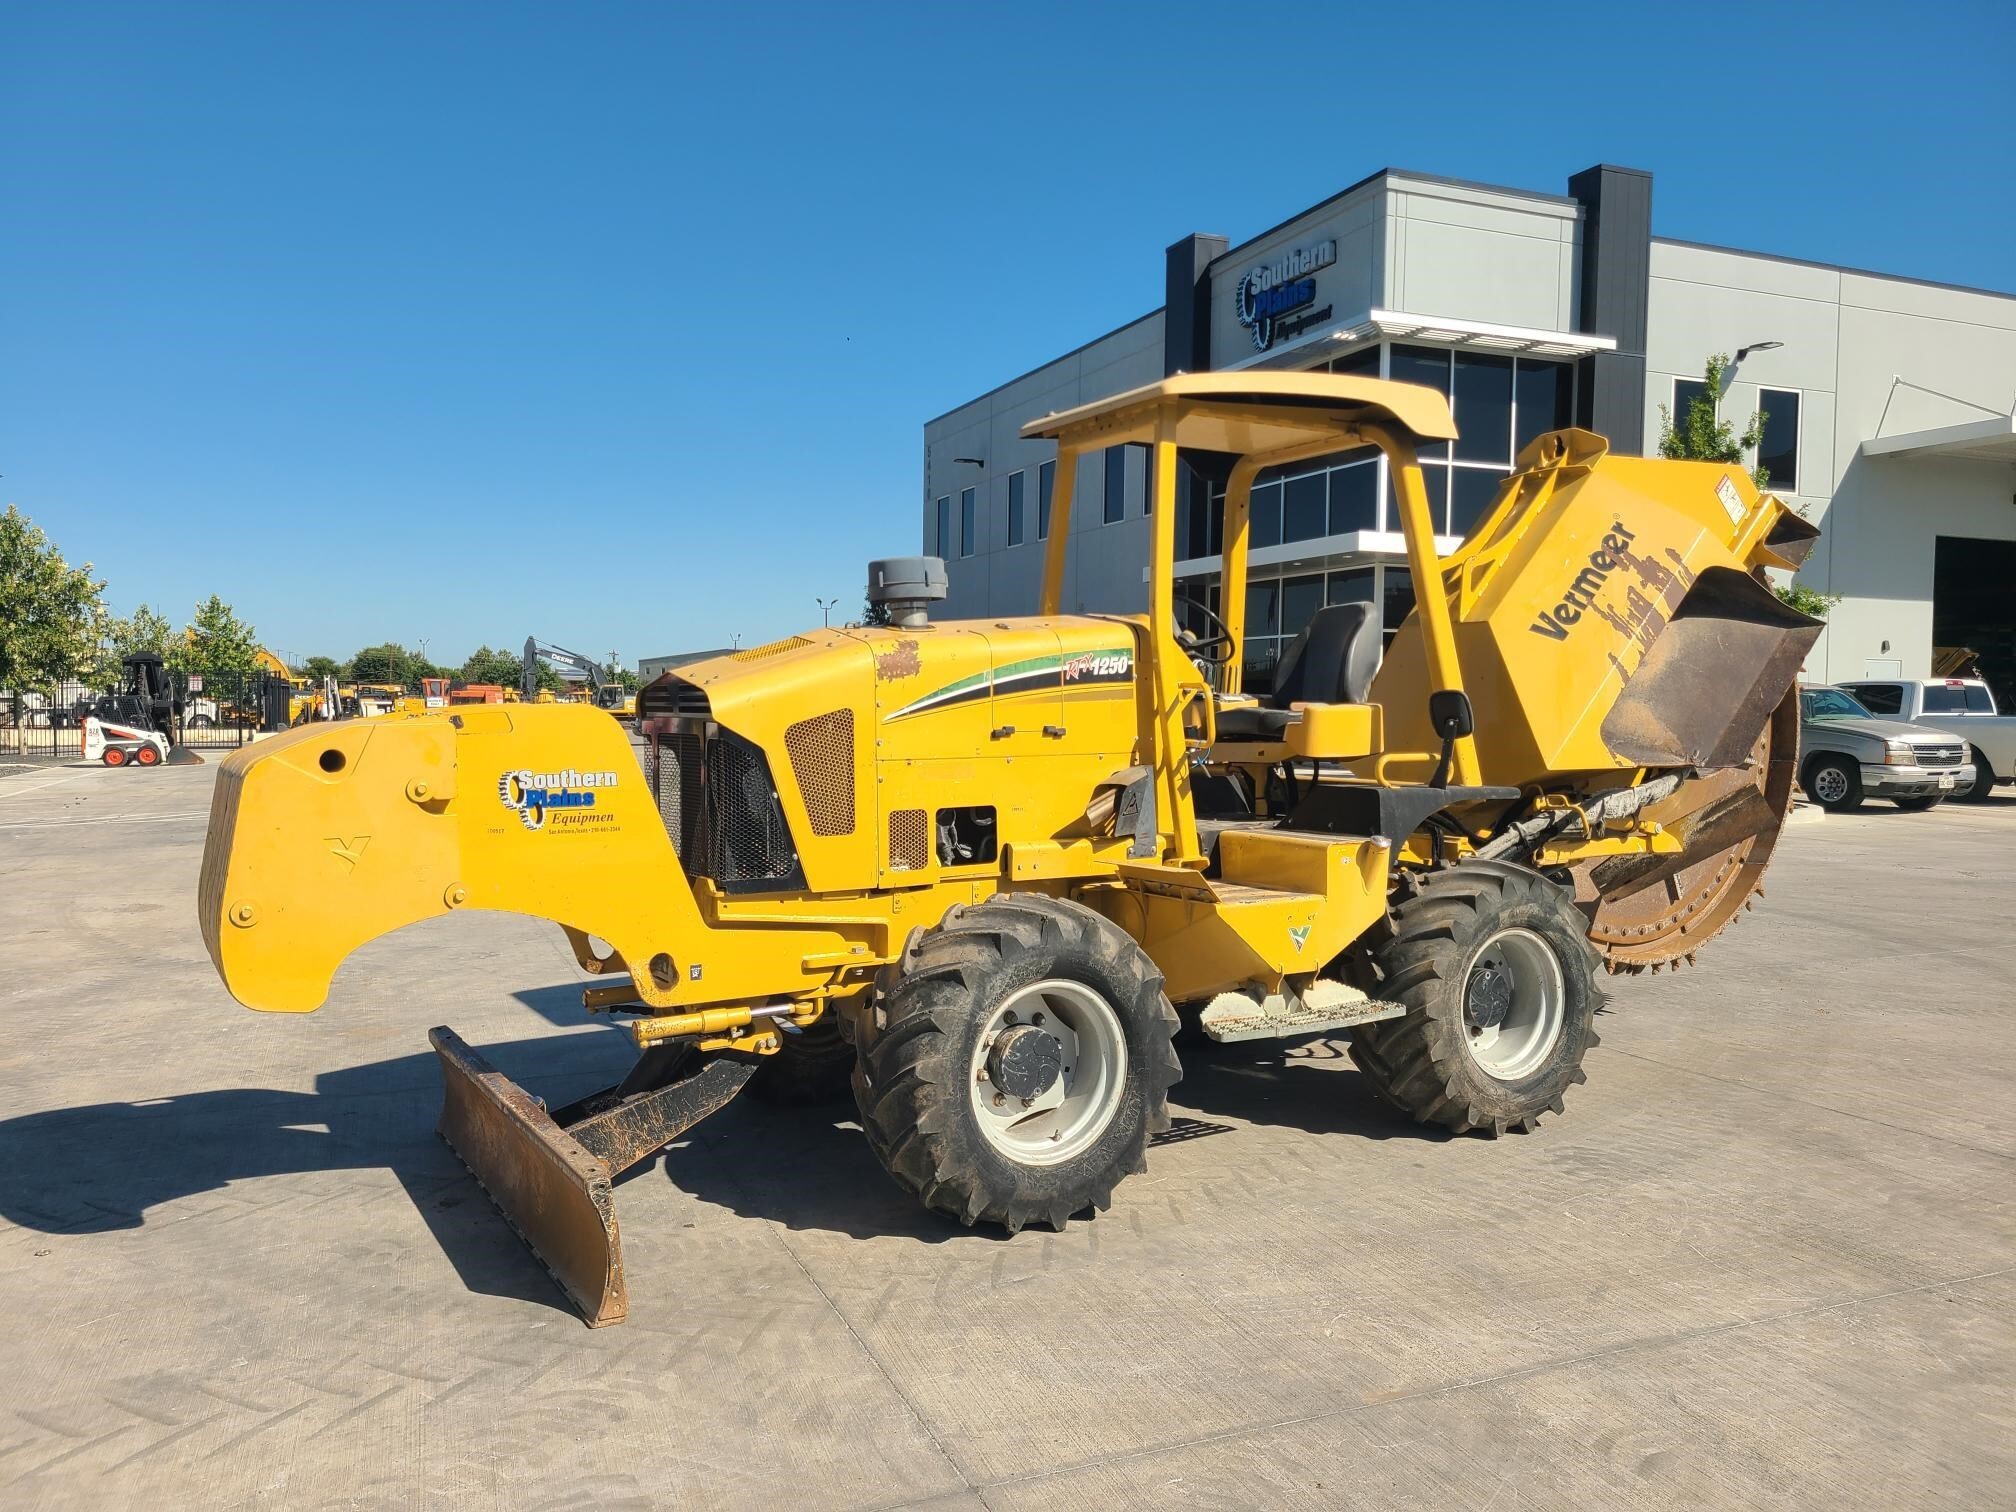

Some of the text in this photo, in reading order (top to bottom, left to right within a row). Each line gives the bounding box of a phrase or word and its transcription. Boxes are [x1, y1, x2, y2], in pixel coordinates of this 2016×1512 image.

[1250, 240, 1334, 295] Southern
[1254, 279, 1316, 321] Plains
[1528, 520, 1636, 641] Vermeer
[1092, 656, 1129, 676] 1250
[518, 768, 618, 790] Southern
[525, 787, 596, 809] Plains
